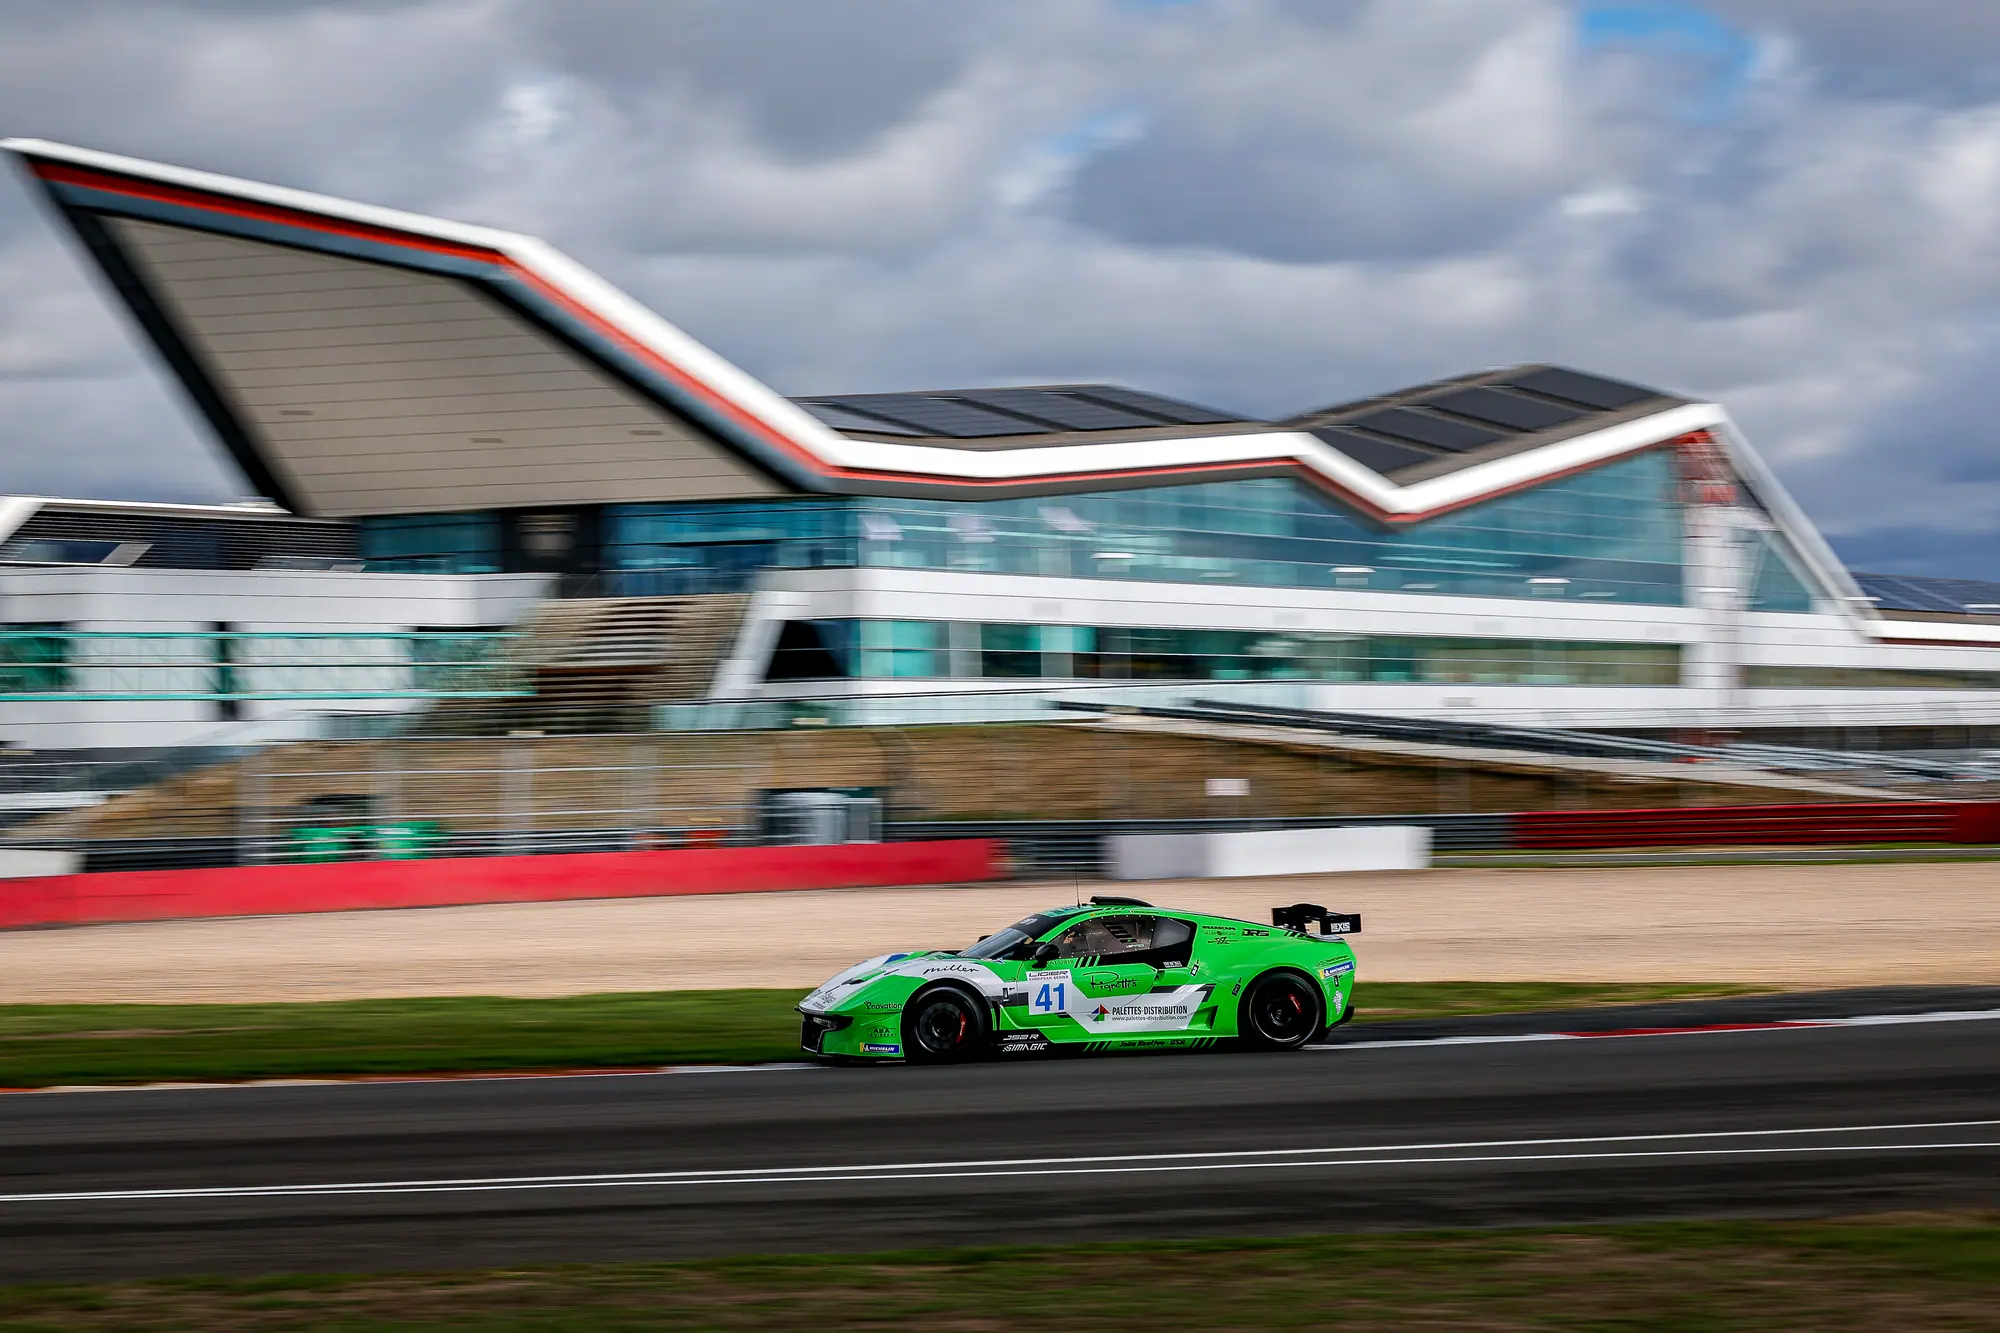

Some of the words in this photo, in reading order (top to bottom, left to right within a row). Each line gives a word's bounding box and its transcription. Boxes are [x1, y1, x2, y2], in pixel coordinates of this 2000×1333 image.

[1242, 928, 1270, 936] DRS
[1330, 922, 1350, 932] NEXIS
[923, 964, 979, 975] miller
[1035, 982, 1065, 1011] 41
[1002, 1043, 1047, 1052] SIMAGIC
